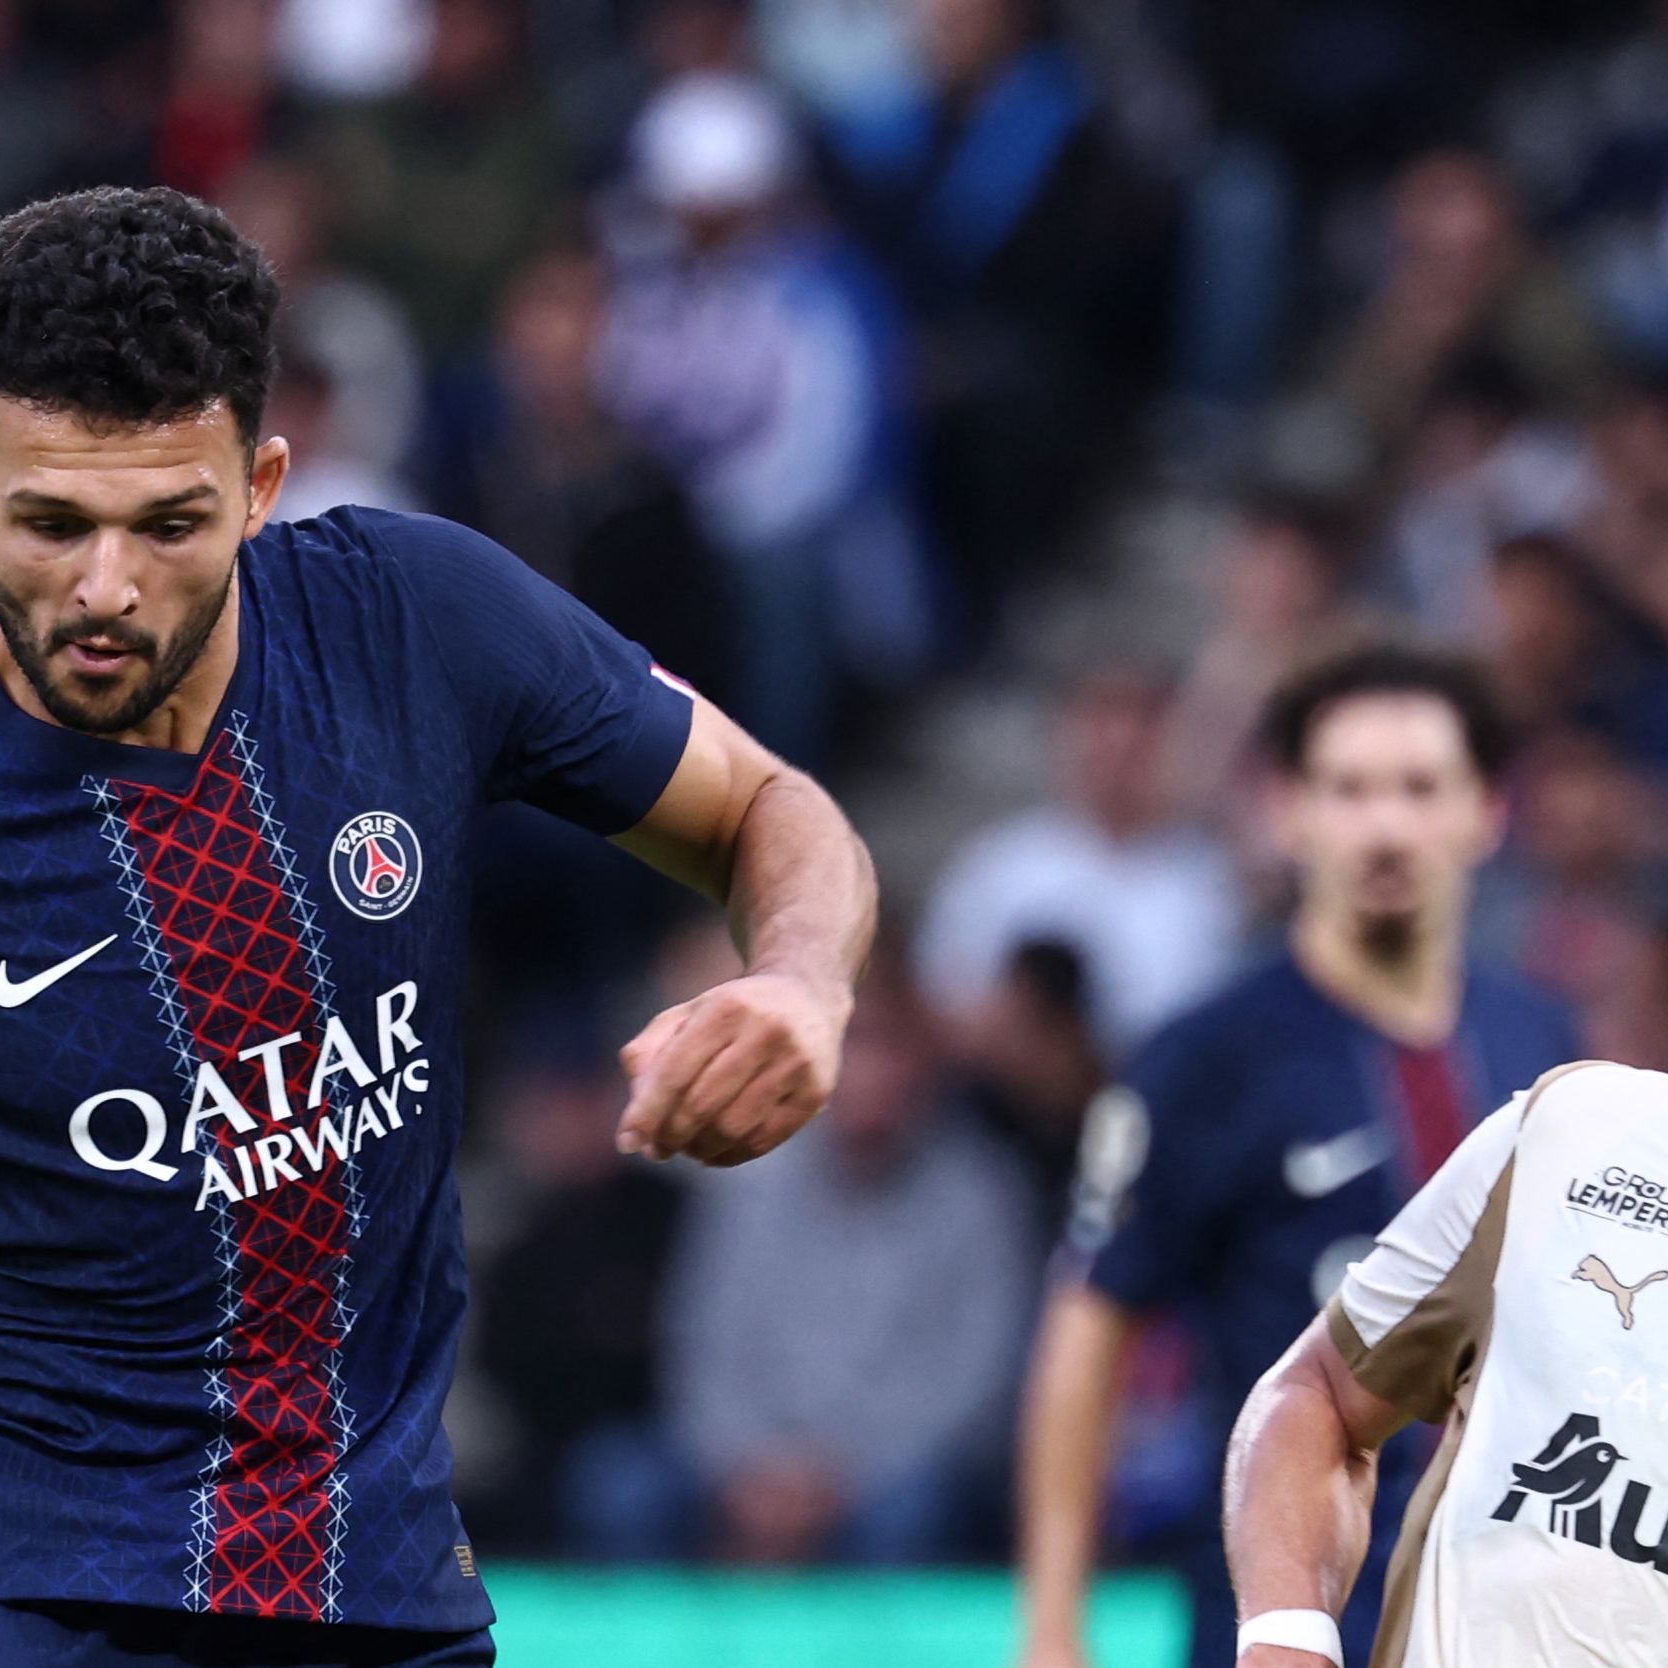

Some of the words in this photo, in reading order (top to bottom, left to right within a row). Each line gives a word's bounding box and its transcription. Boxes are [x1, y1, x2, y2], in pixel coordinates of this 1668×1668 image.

[337, 816, 397, 855] PARIS
[69, 980, 423, 1182] QATAR
[194, 1058, 430, 1212] AIRWAYS
